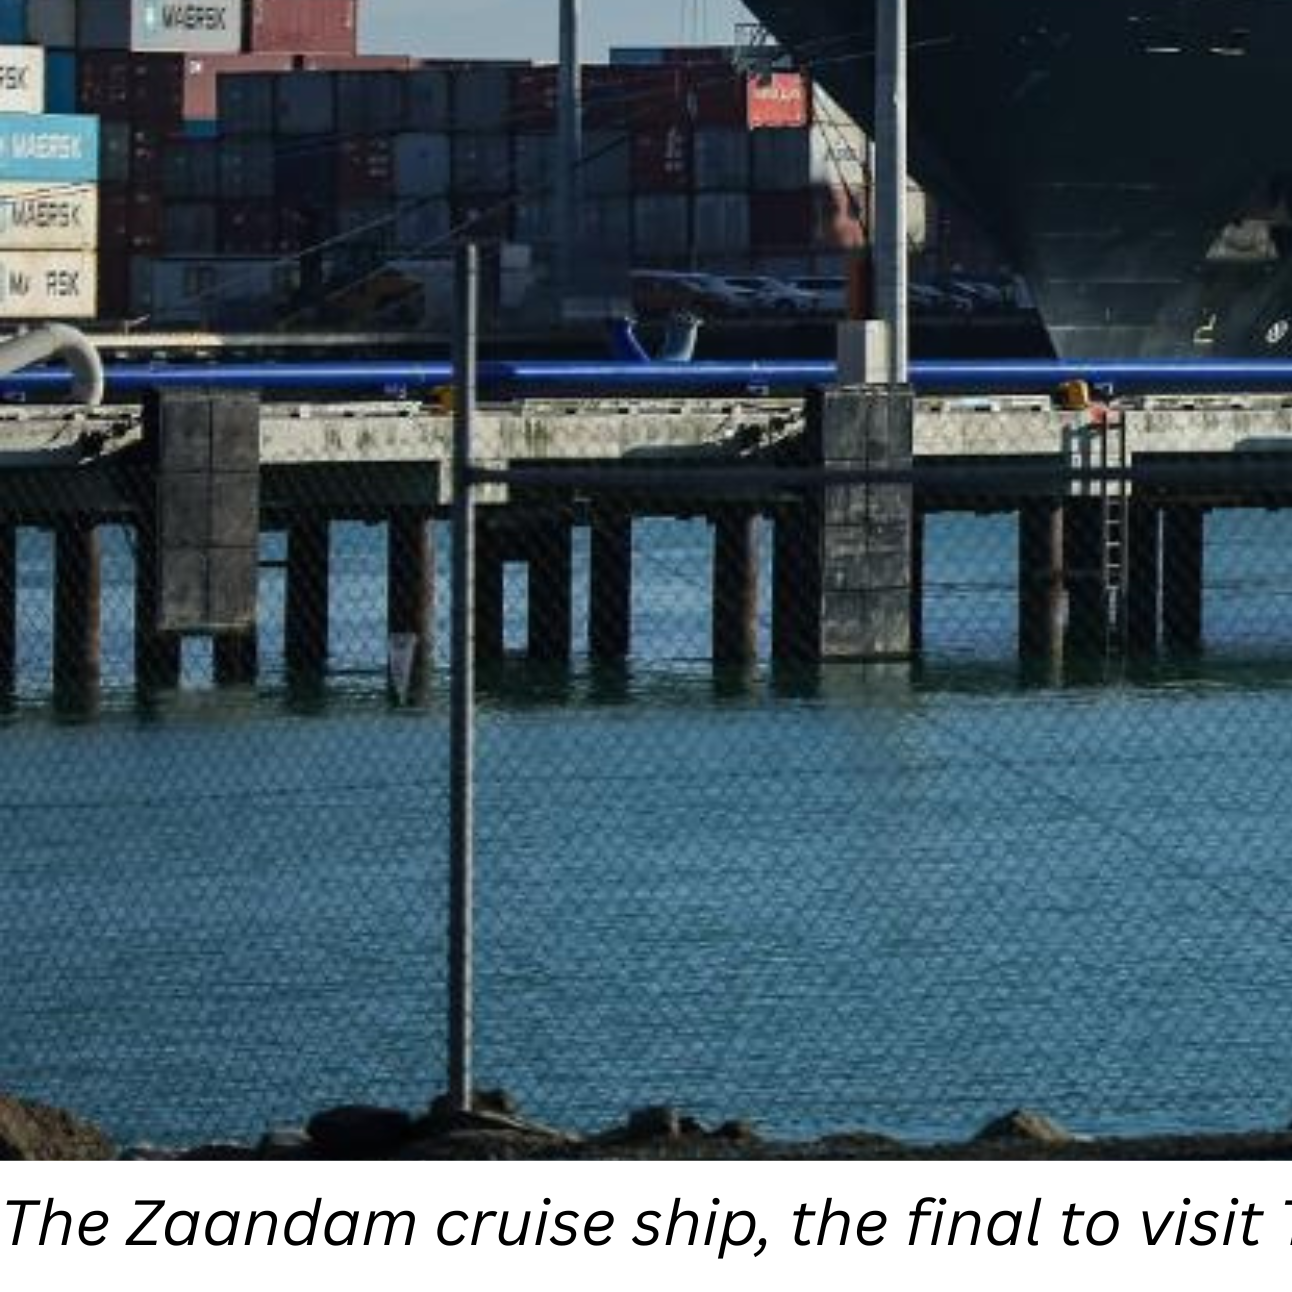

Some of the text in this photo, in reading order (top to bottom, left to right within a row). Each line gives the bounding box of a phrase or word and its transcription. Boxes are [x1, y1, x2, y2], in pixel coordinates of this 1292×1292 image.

[161, 5, 227, 30] MAERSK
[10, 131, 82, 159] MAERSK
[11, 200, 82, 228] MAERSK
